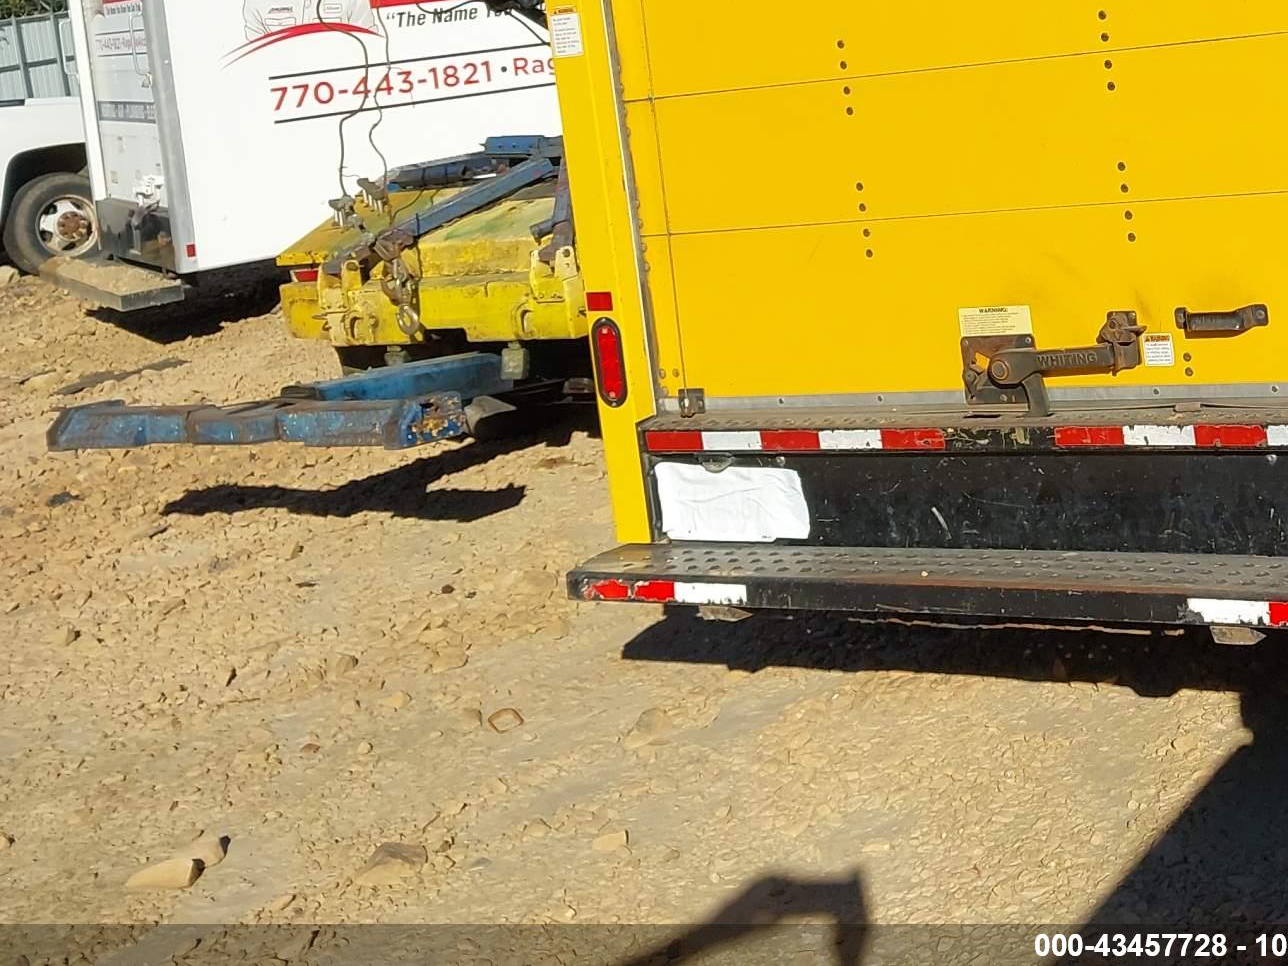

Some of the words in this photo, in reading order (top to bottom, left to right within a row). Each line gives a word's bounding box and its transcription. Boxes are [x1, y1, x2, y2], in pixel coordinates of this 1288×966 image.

[432, 7, 478, 24] Name
[270, 60, 493, 111] 770-443-1821
[1037, 351, 1097, 369] WHITING
